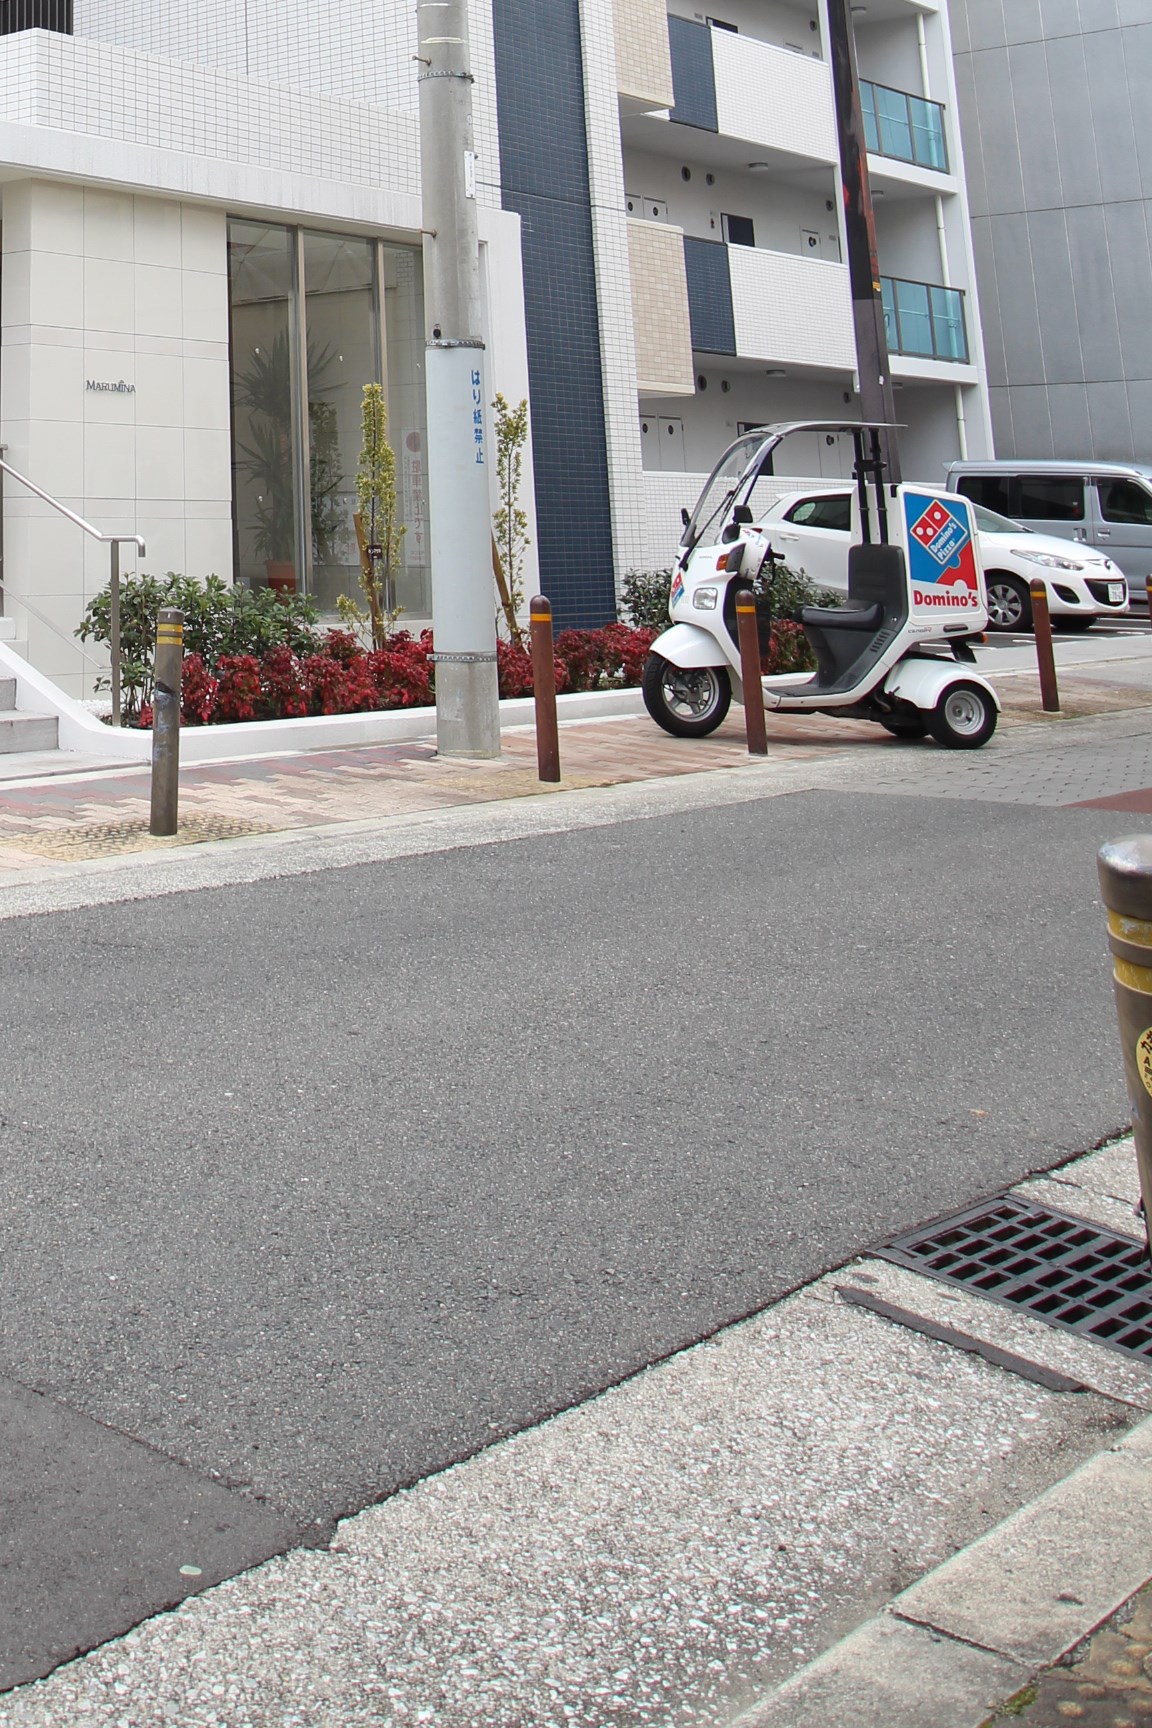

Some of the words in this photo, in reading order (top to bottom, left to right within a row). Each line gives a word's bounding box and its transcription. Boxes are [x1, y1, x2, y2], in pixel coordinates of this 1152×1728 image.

[471, 369, 484, 464] はり紙禁止
[930, 521, 957, 553] Domino's
[938, 540, 955, 561] Pizza
[913, 590, 978, 608] Domino's
